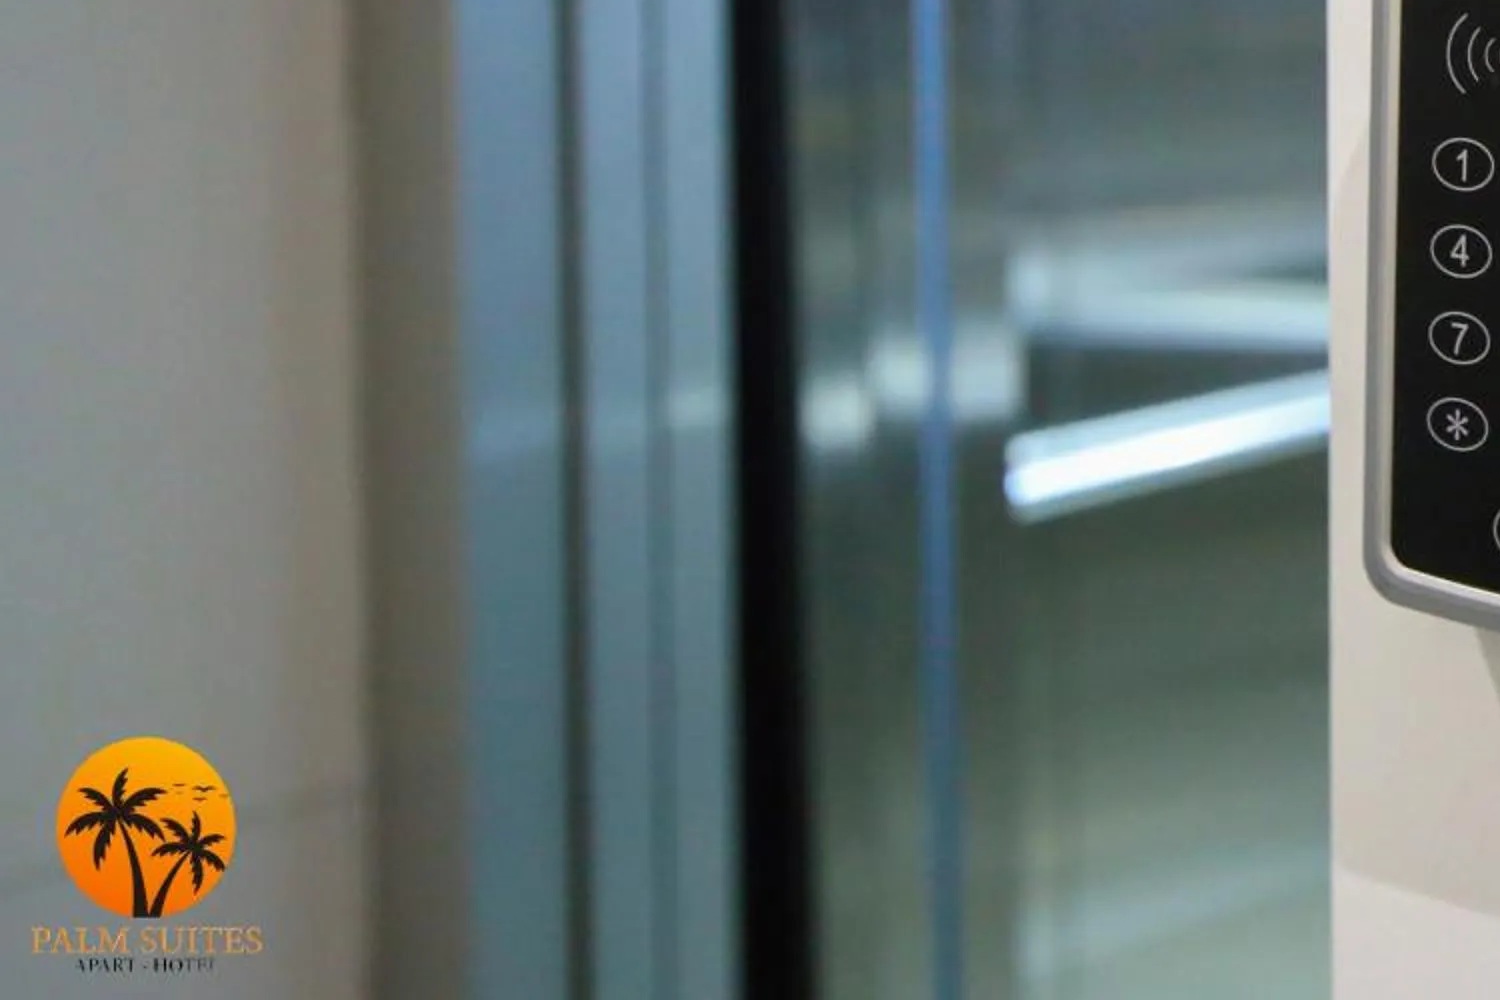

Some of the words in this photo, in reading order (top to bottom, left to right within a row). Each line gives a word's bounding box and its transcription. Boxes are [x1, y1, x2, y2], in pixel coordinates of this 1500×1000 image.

[1455, 149, 1468, 182] 1
[1450, 234, 1470, 267] 4
[1451, 322, 1469, 355] 7
